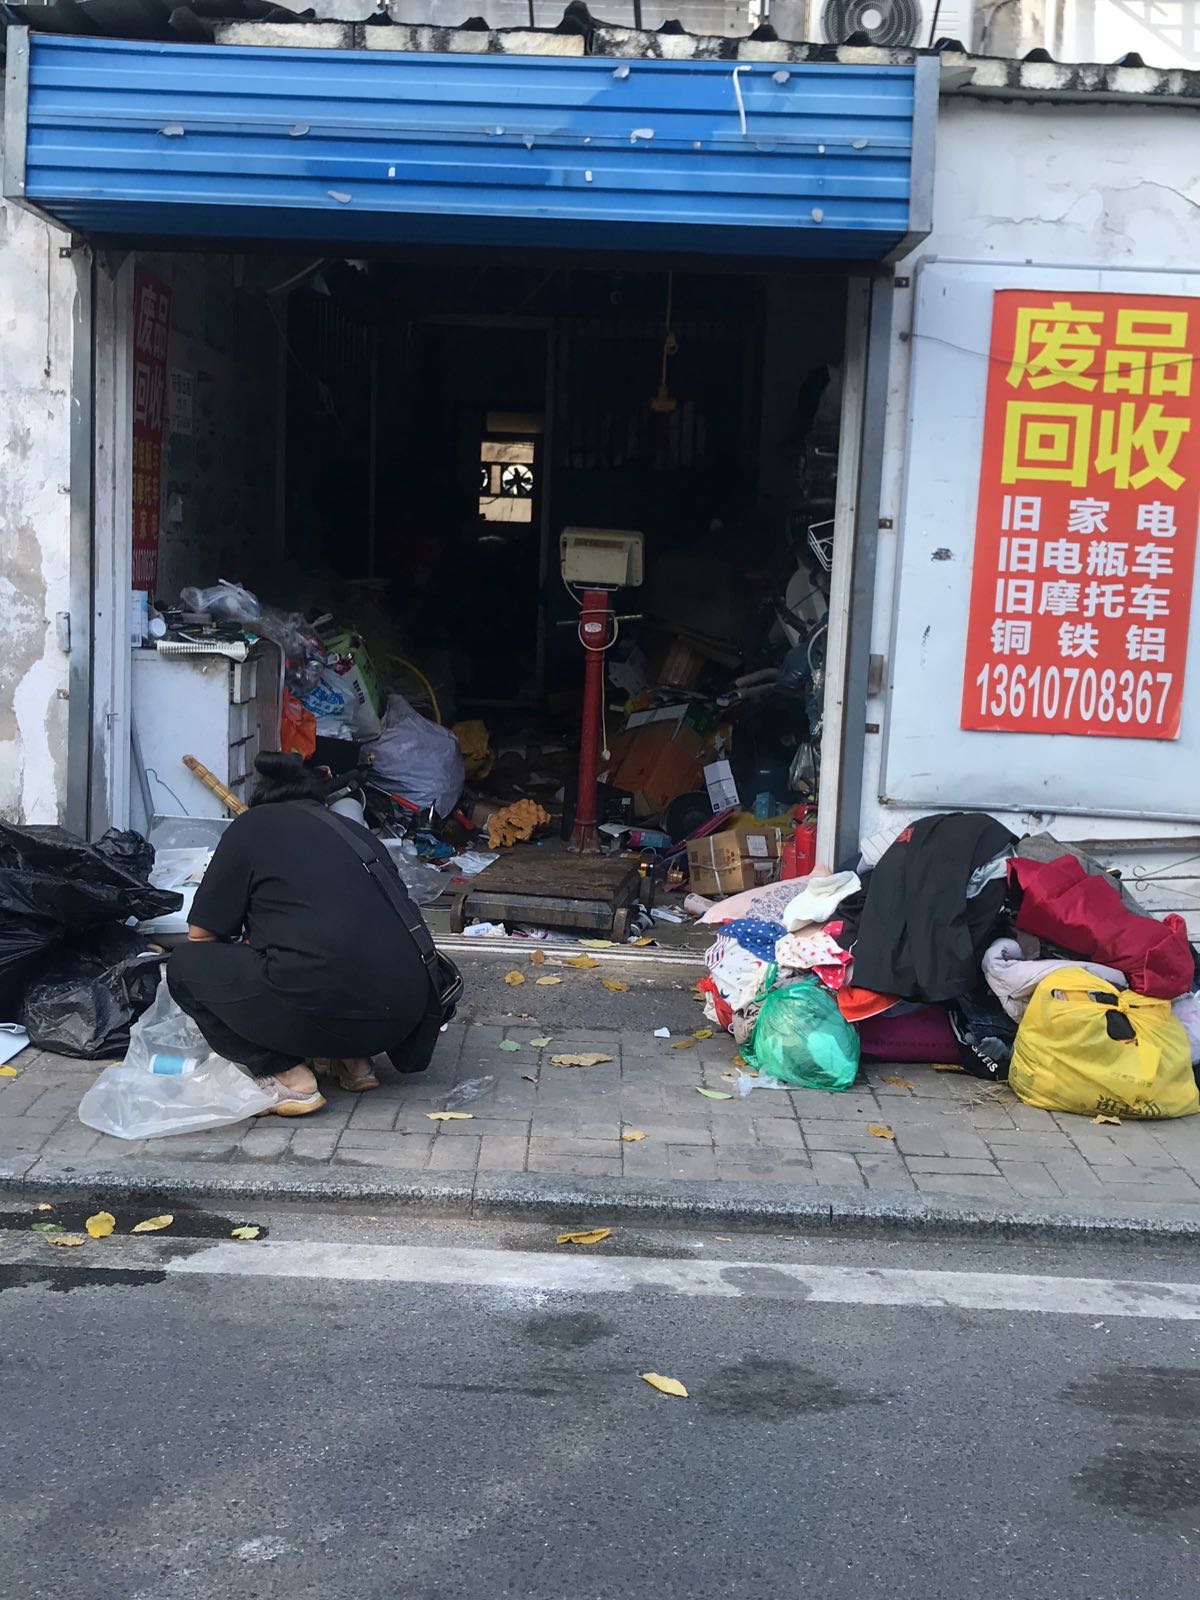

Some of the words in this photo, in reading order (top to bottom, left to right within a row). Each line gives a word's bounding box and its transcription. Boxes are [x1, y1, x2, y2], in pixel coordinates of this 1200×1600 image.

[136, 284, 168, 359] 废品
[1005, 302, 1194, 398] 废品
[134, 361, 165, 431] 回收
[1000, 400, 1191, 491] 回收
[998, 537, 1175, 580] 旧电瓶车
[993, 578, 1171, 621] 旧摩托车
[975, 663, 1173, 725] 13610708367
